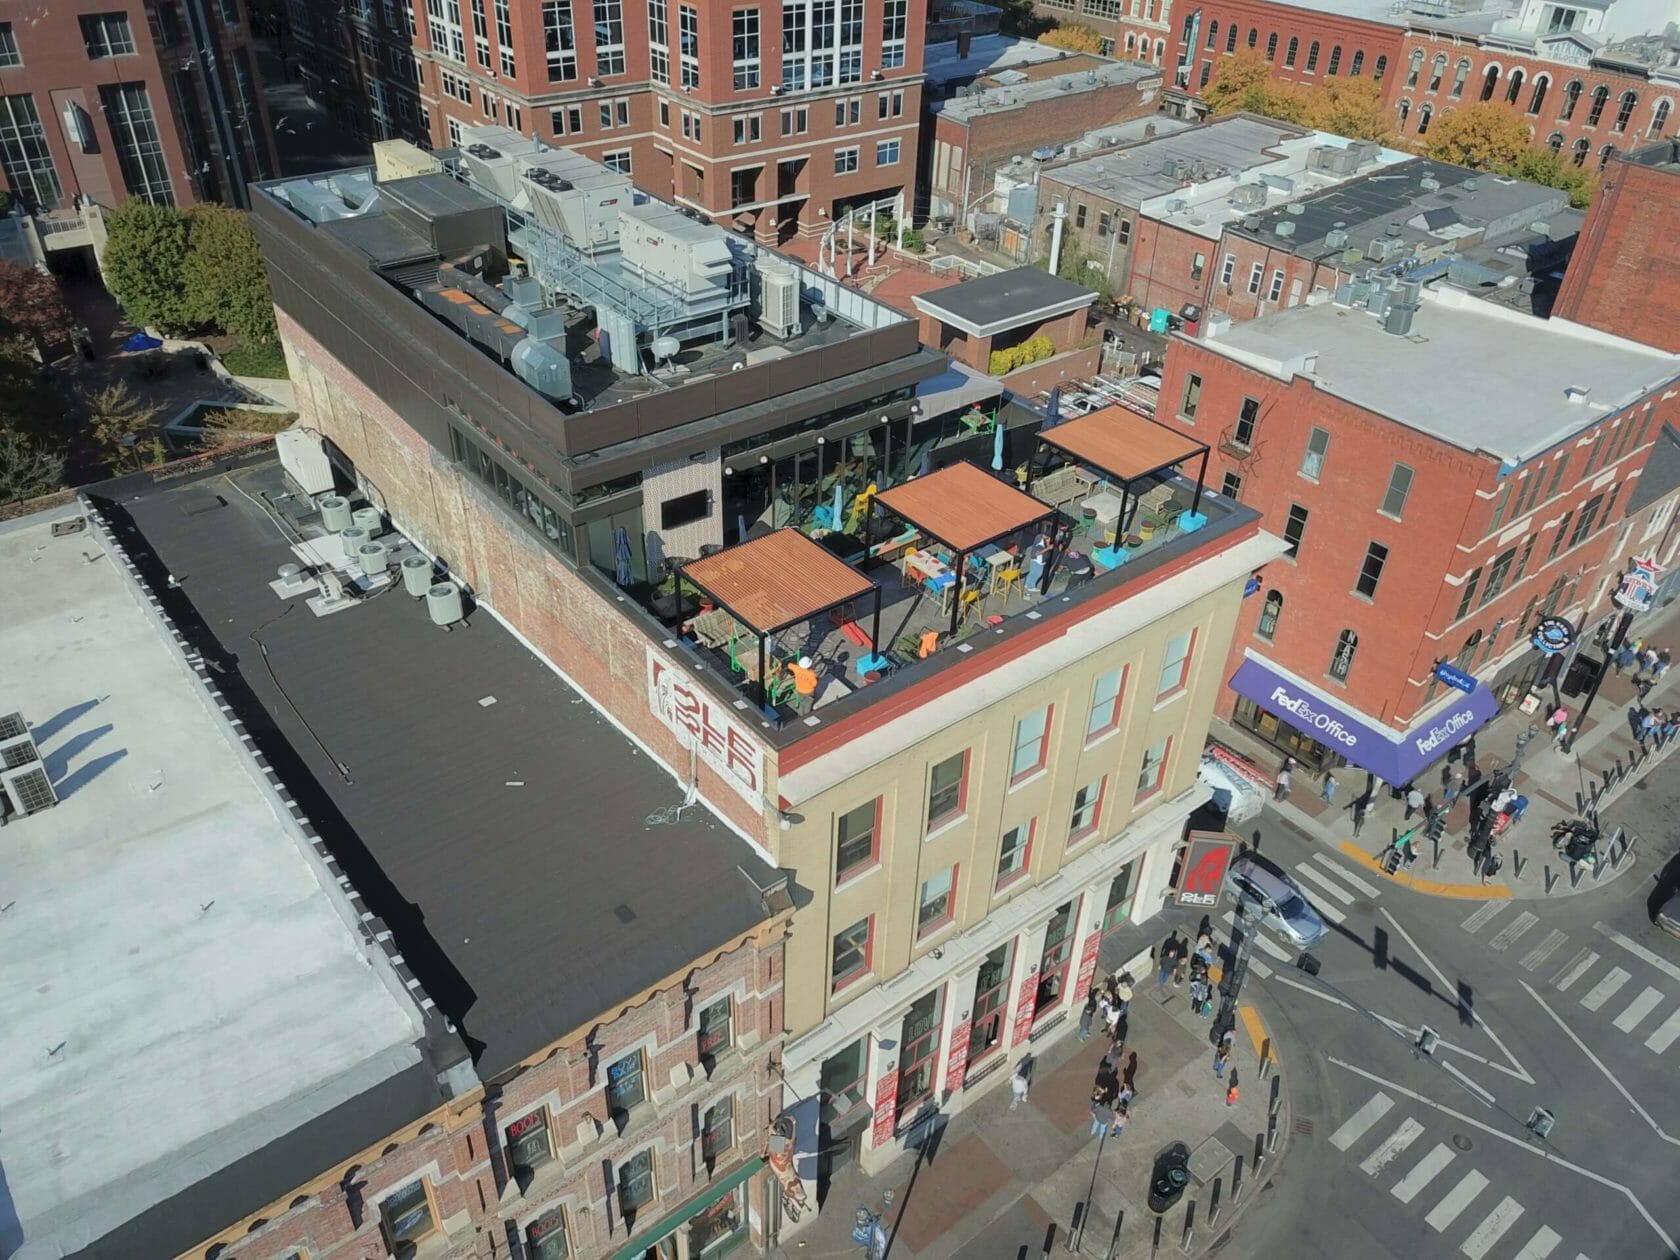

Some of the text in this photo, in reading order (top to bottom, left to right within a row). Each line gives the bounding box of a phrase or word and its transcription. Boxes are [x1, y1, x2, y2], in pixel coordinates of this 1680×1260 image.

[1270, 685, 1358, 748] FedEx Office
[1415, 708, 1475, 755] FedEx Office
